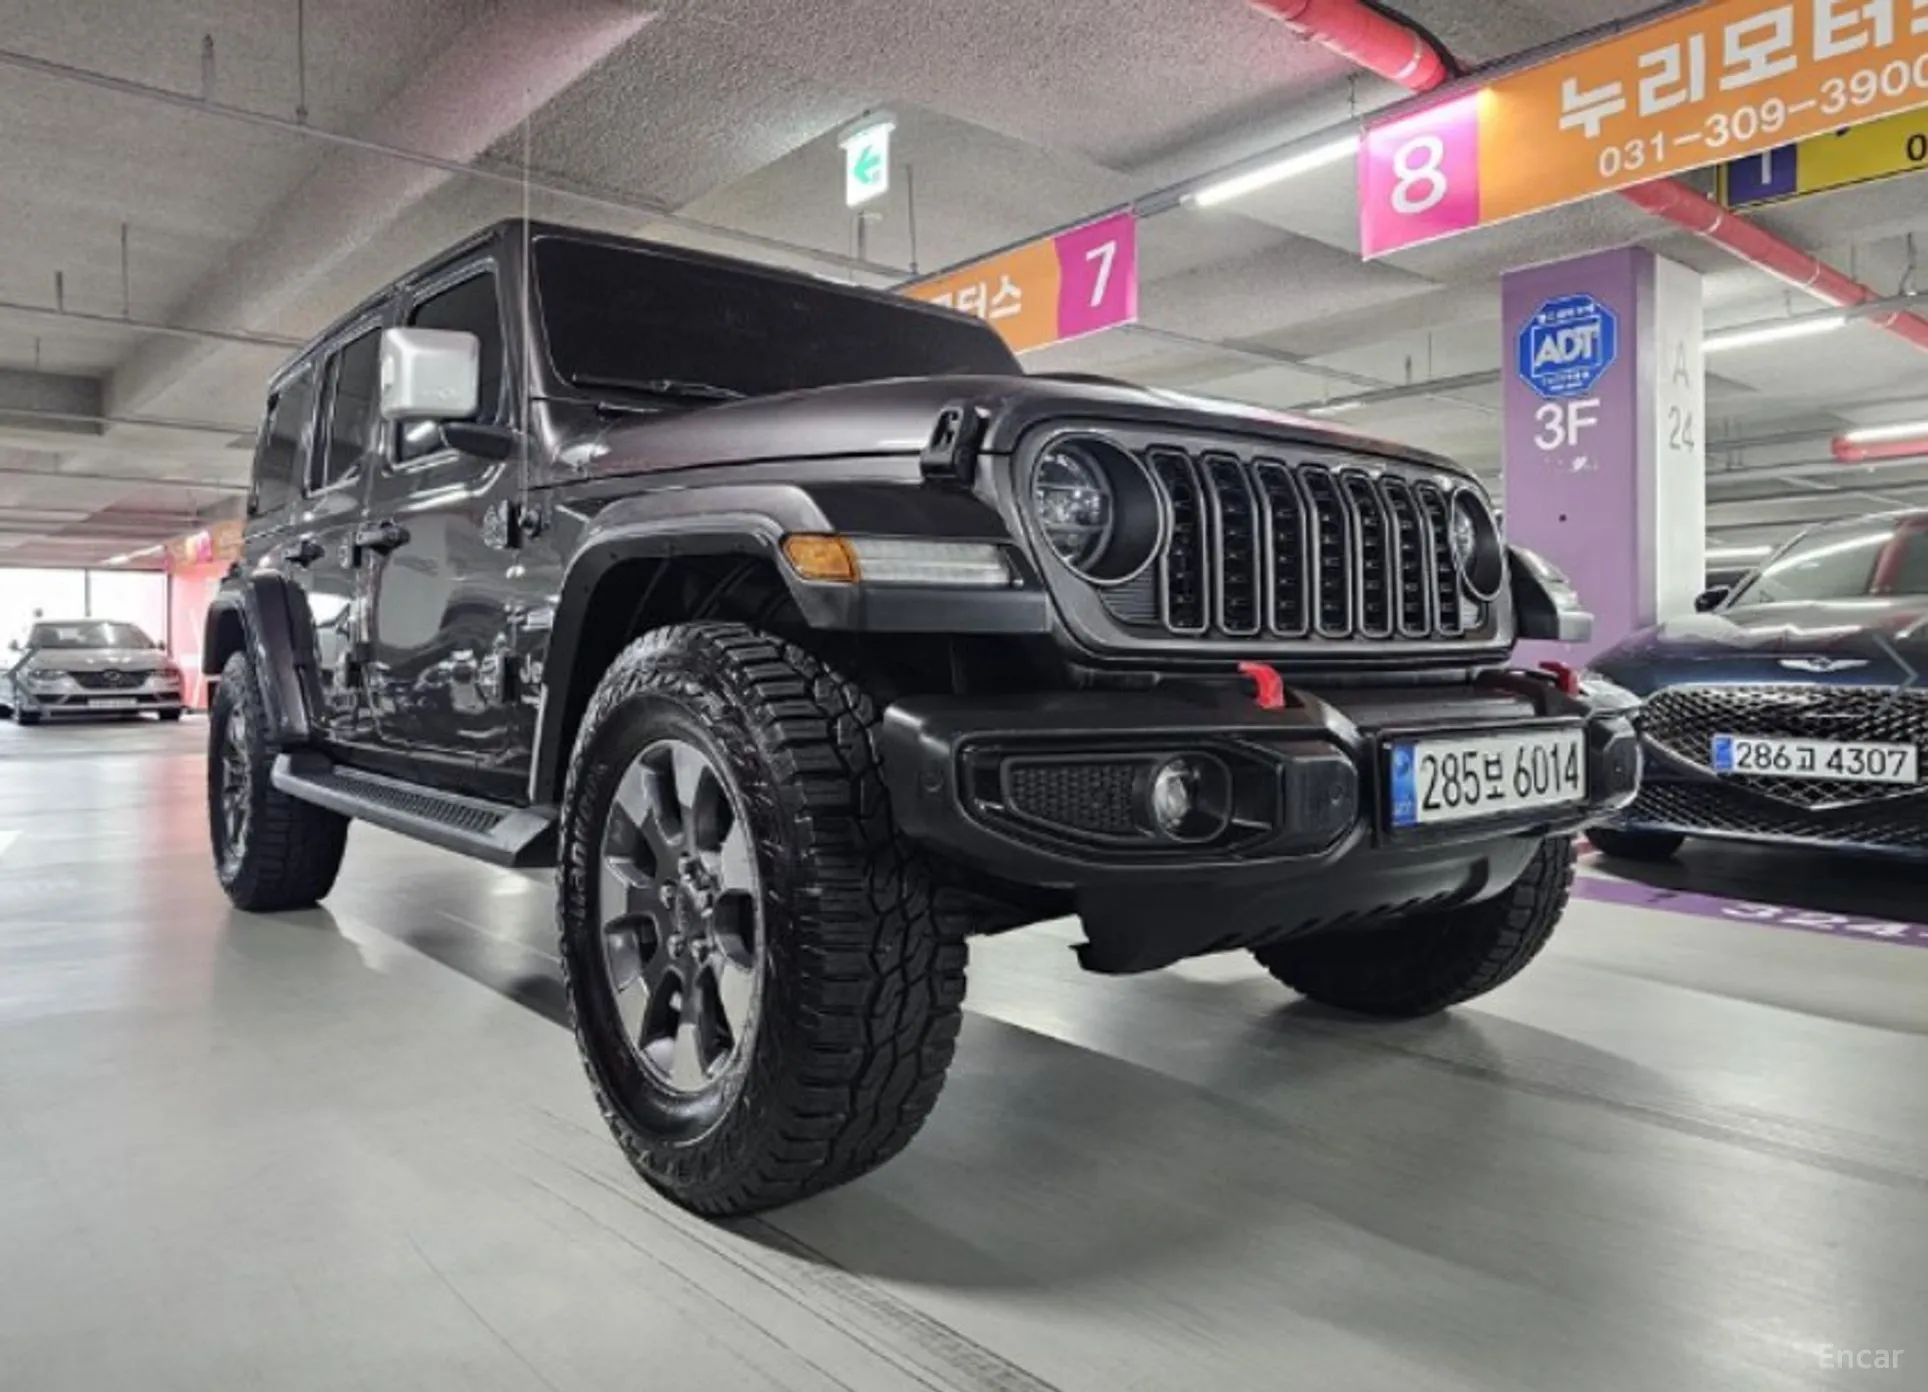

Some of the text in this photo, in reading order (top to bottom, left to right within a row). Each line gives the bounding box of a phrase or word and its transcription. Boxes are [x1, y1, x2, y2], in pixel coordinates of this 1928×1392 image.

[1559, 0, 1928, 139] 누리모터
[1390, 135, 1447, 214] 8
[1086, 240, 1118, 308] 7
[1533, 322, 1600, 367] ADT
[1533, 397, 1600, 450] 3F
[1512, 741, 1579, 798] 6014
[1826, 747, 1909, 777] 4307
